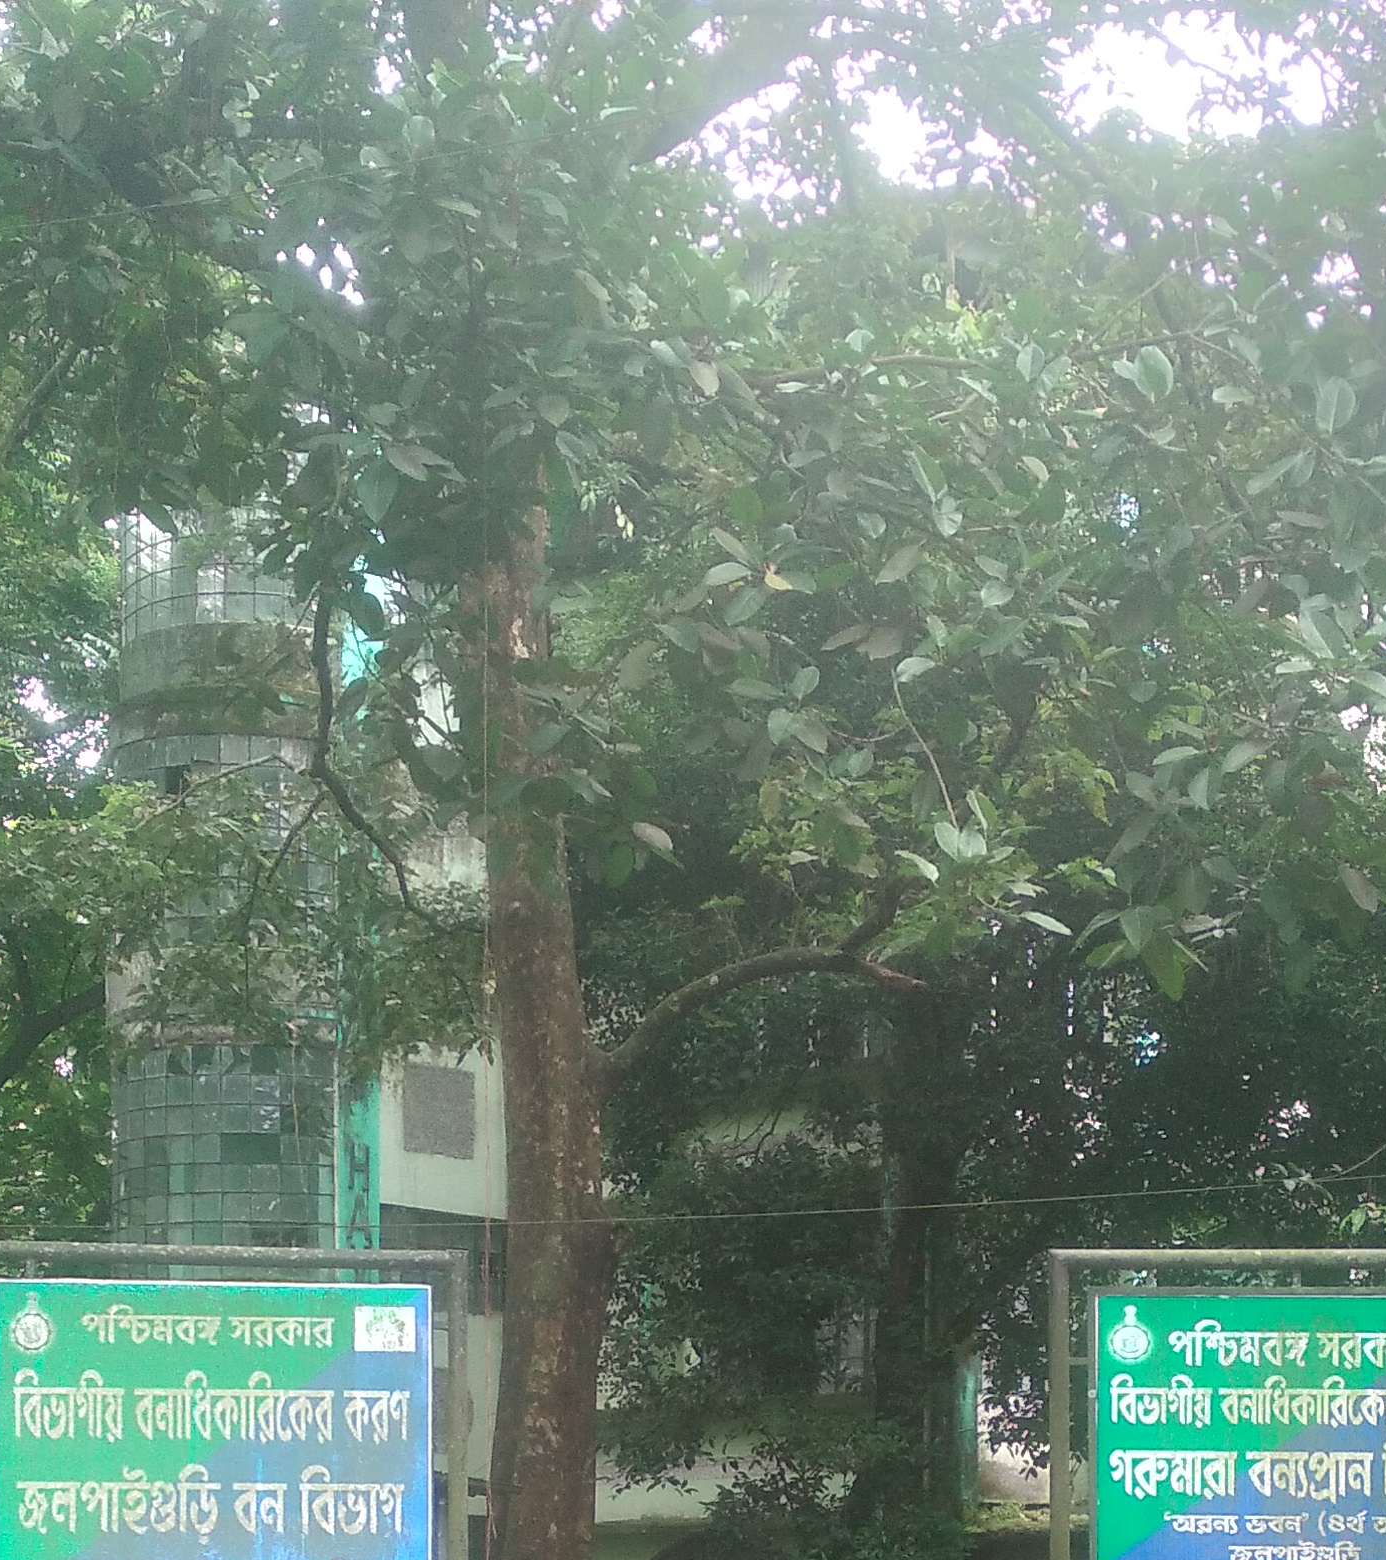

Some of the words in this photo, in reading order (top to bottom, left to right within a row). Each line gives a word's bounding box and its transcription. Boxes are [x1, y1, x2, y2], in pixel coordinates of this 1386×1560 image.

[81, 1303, 221, 1348] পশ্চিমবঙ্গ
[229, 1315, 335, 1348] সরকার
[1168, 1319, 1310, 1368] পশ্চিমবঙ্গ
[12, 1369, 124, 1443] বিভাগীয়
[134, 1370, 335, 1445] বনাধিকারিকের
[343, 1388, 411, 1445] করণ
[1109, 1374, 1213, 1429] বিভাগীয়
[1108, 1448, 1238, 1502] গরুমারা
[16, 1463, 222, 1545] জলপাইগুড়ি
[232, 1482, 288, 1534] বন
[299, 1464, 406, 1537] বিভাগ
